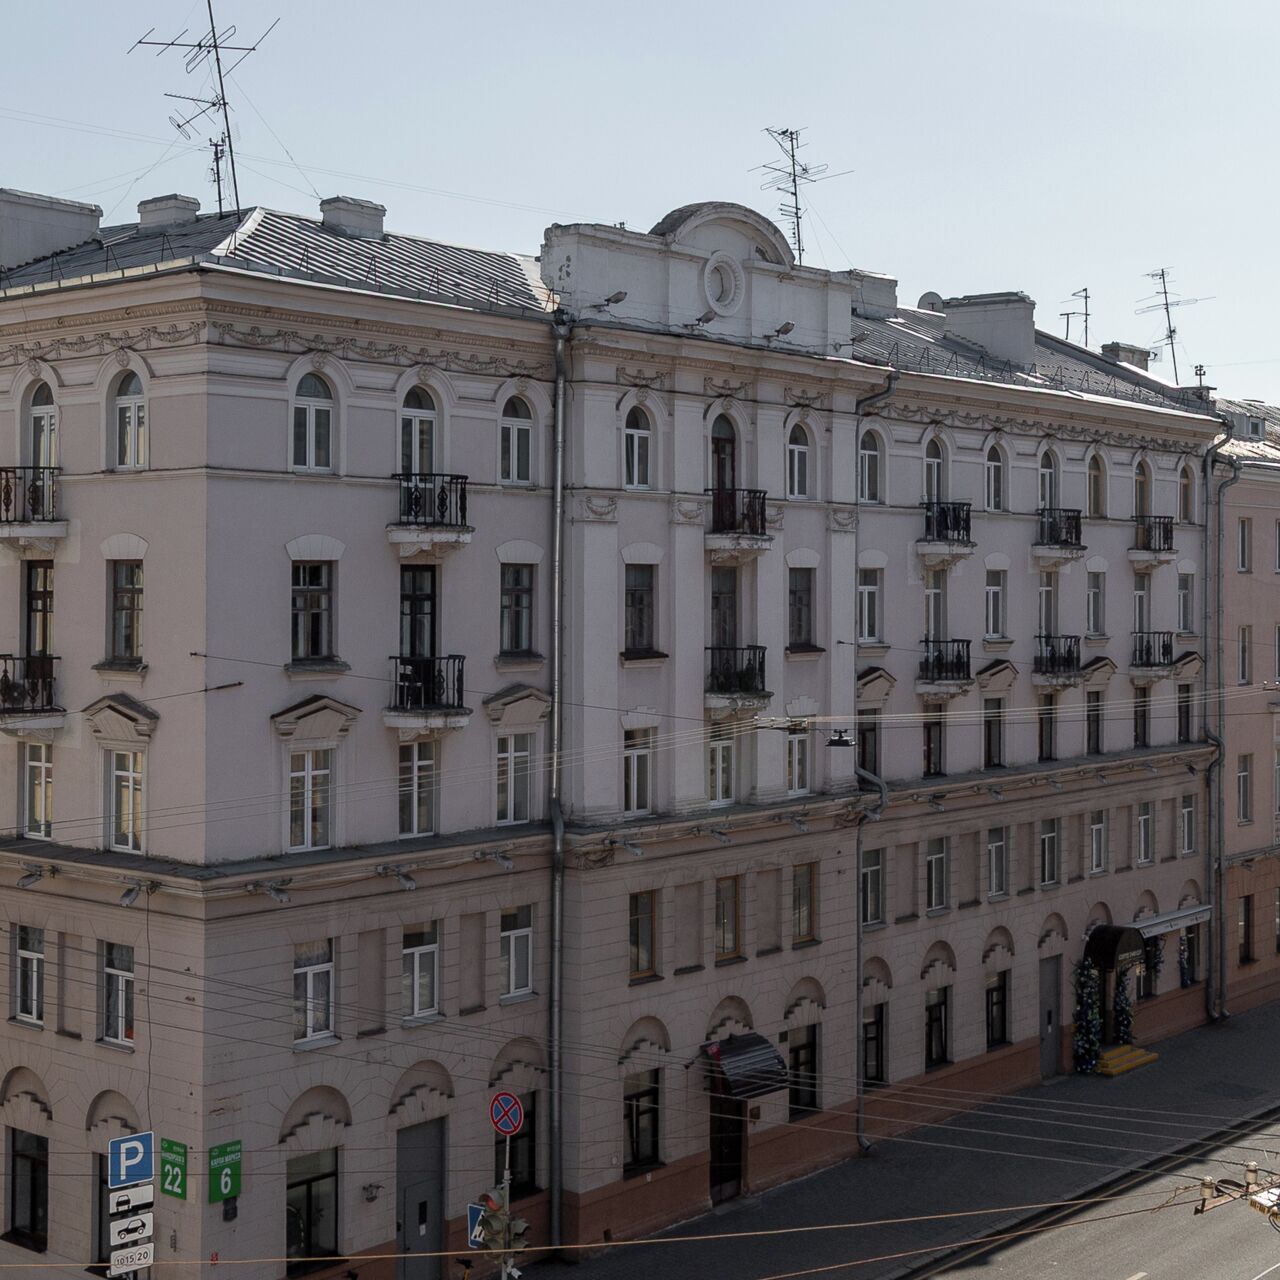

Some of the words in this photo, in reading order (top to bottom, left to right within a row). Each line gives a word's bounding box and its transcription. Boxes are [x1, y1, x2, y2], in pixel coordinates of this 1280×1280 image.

[120, 1140, 144, 1181] P
[164, 1164, 182, 1194] 22
[220, 1167, 232, 1195] 6
